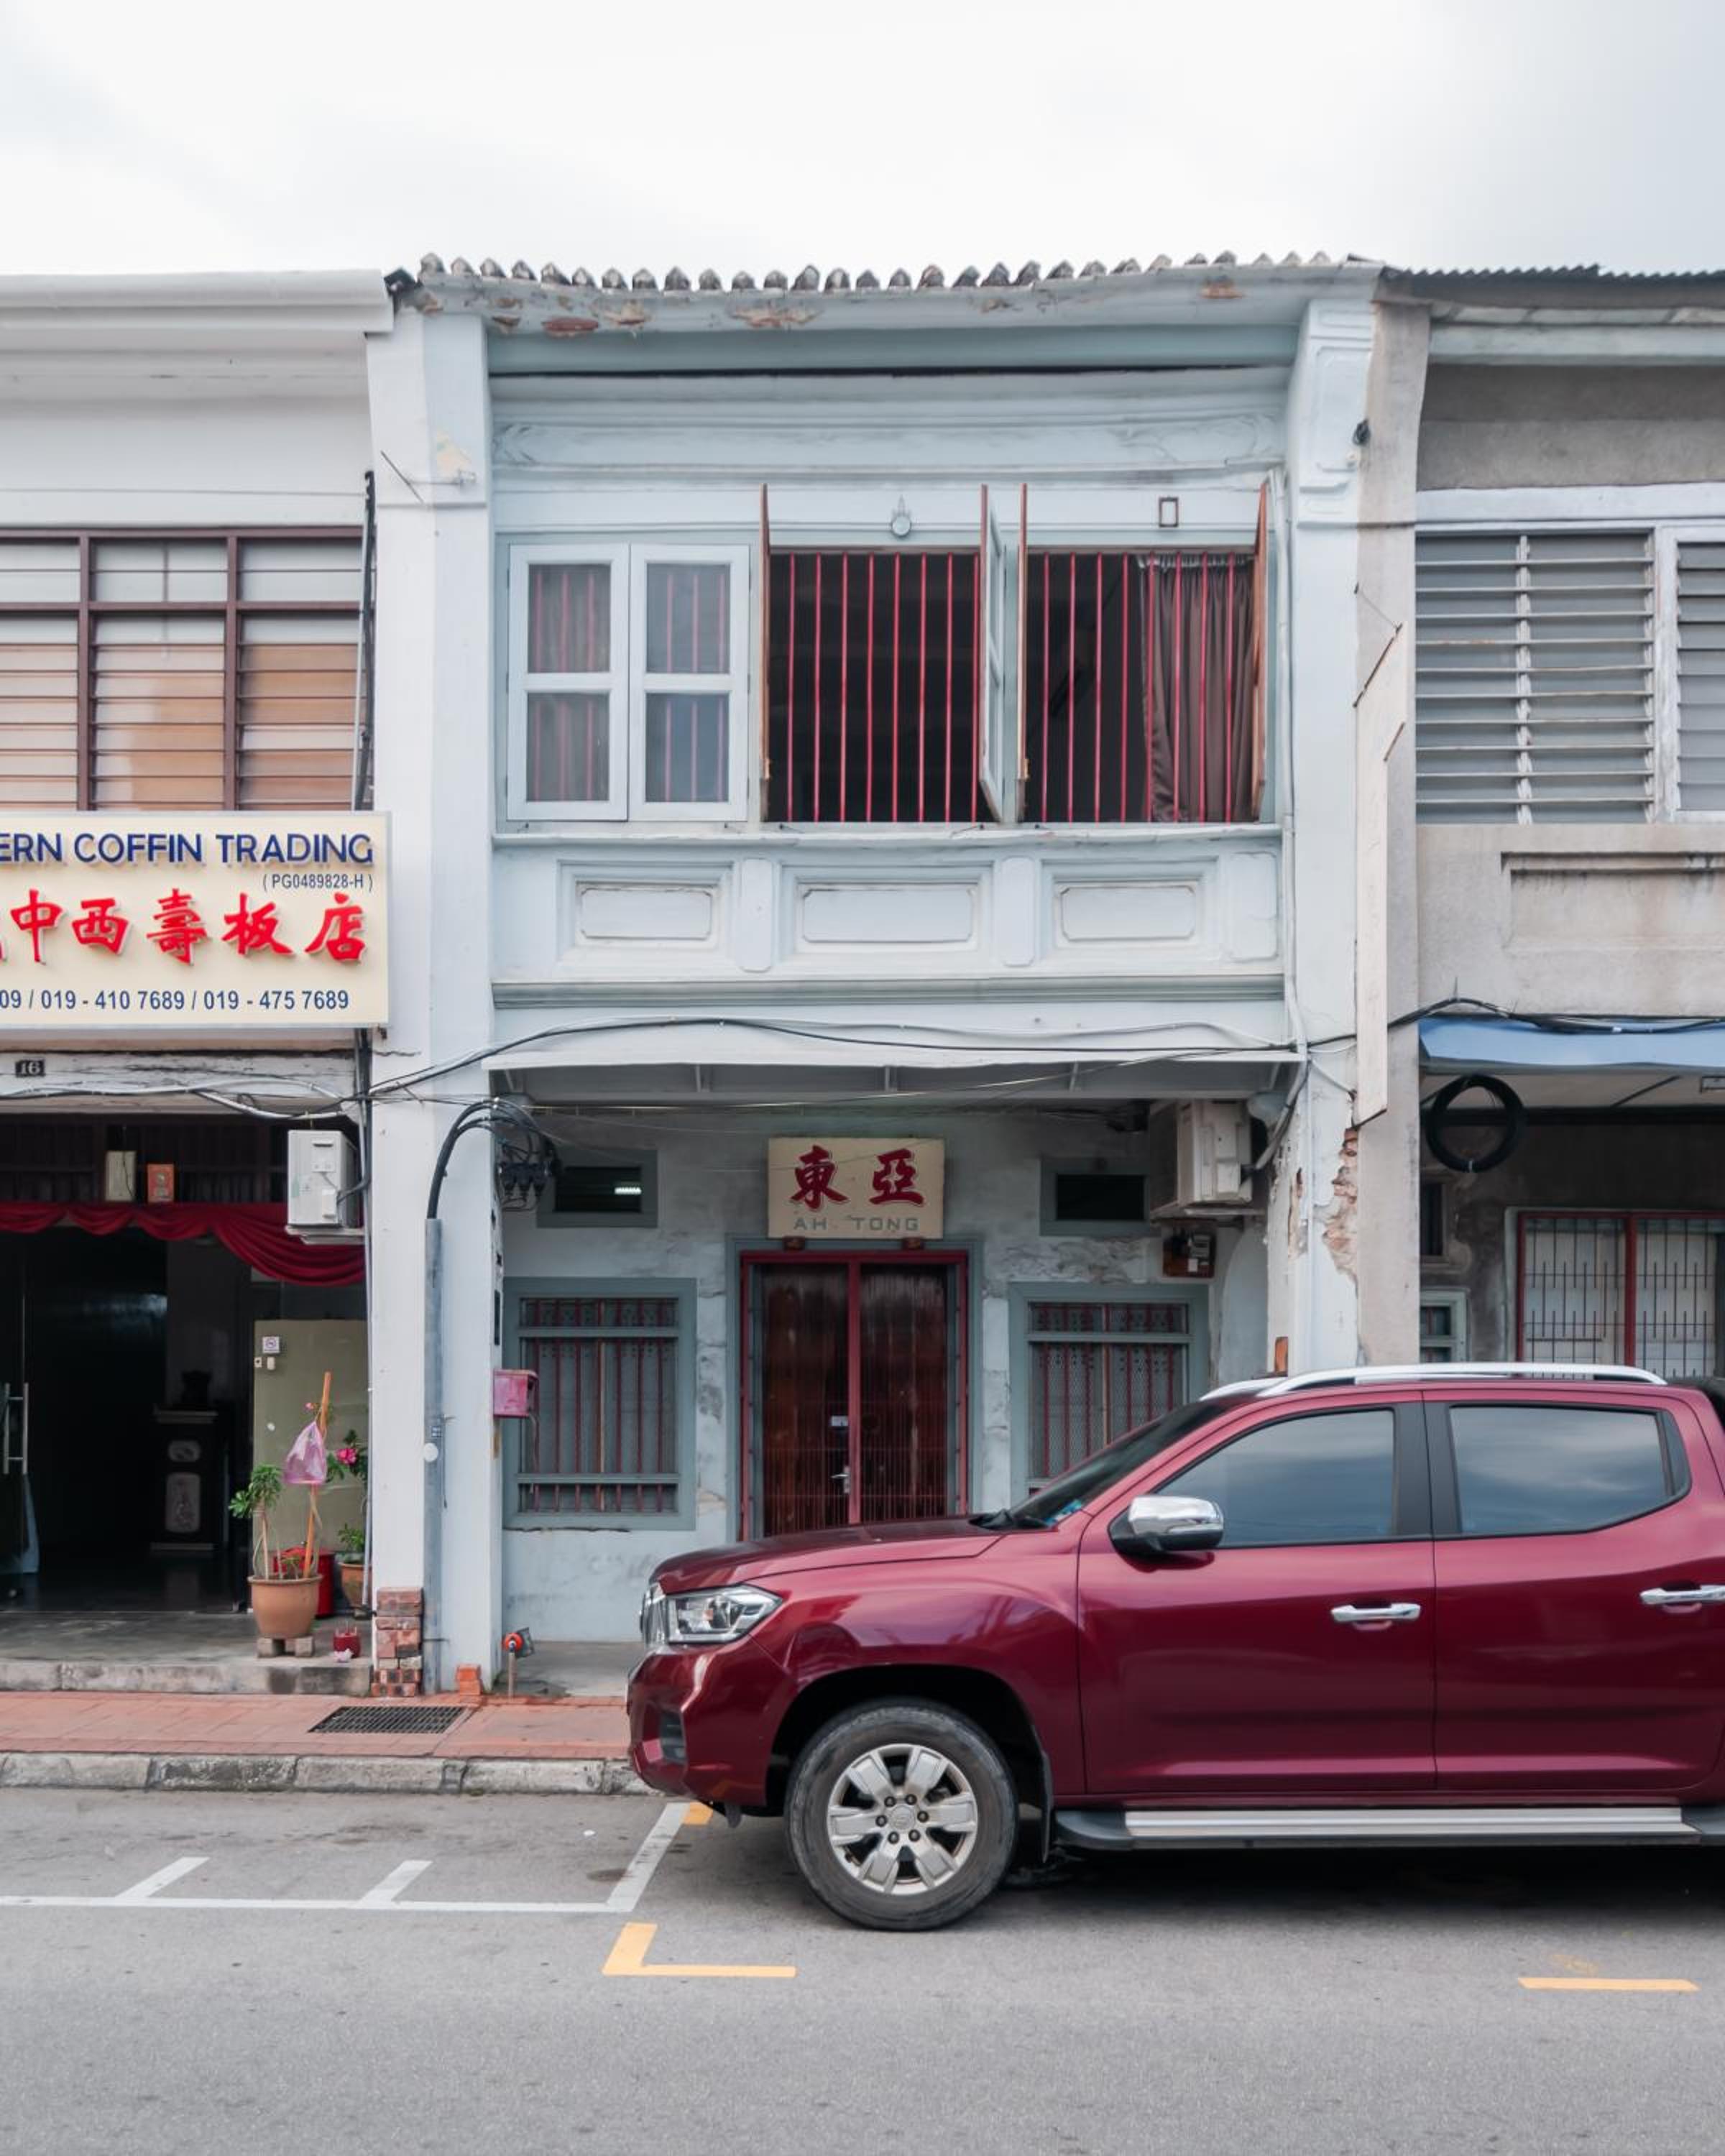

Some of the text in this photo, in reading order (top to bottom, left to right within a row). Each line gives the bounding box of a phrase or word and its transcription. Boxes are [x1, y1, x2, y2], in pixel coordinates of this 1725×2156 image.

[74, 833, 202, 863] COFFIN
[216, 834, 373, 864] TRADING
[272, 874, 363, 889] PG0489828-H
[0, 888, 365, 964] 中西壽板店
[41, 990, 76, 1009] 019
[95, 990, 130, 1009] 410
[137, 990, 185, 1010] 7689
[203, 990, 239, 1010] 019
[259, 990, 295, 1010] 475
[303, 990, 349, 1010] 7689
[22, 1061, 41, 1075] 16
[794, 1216, 919, 1231] AH TONG
